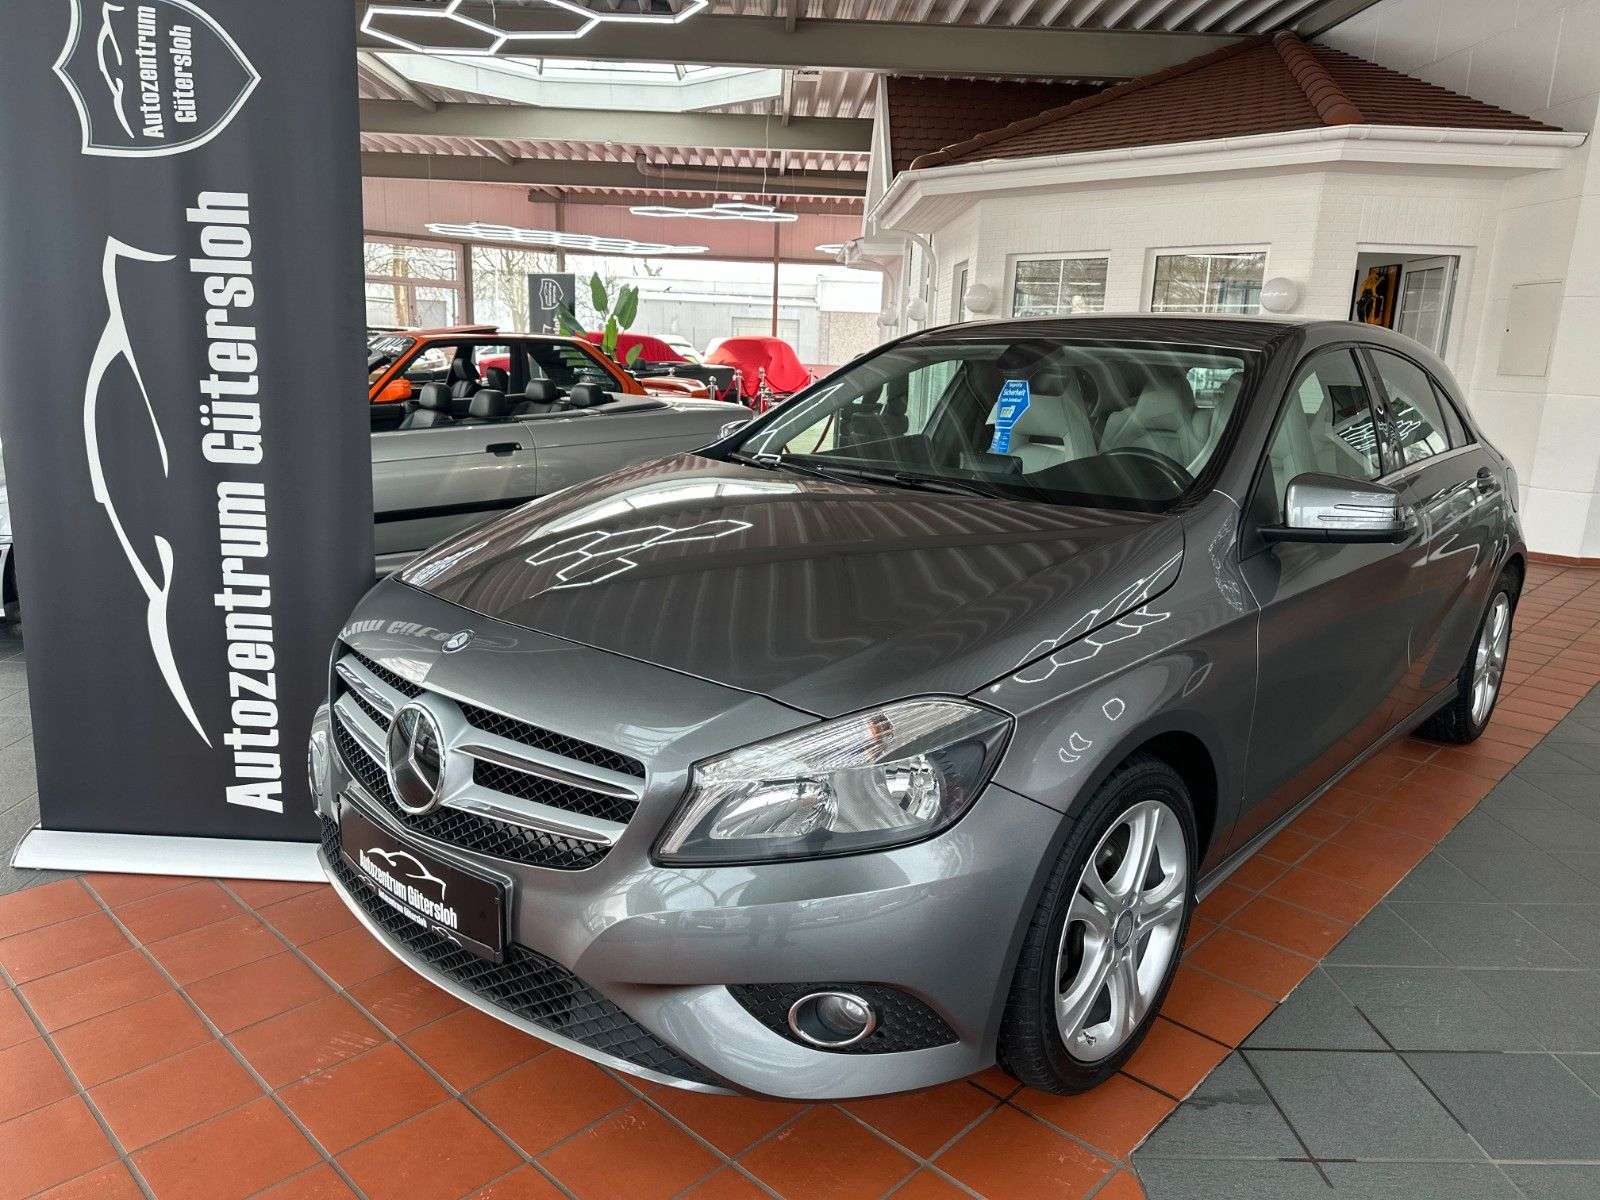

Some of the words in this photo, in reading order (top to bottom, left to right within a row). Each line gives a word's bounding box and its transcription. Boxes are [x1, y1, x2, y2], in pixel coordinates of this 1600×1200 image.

[136, 5, 165, 138] Autozentrum
[169, 25, 197, 124] Gütersloh
[186, 191, 264, 465] Gütersloh
[214, 481, 284, 814] Autozentrum
[359, 849, 407, 901] Autozentrum
[407, 885, 458, 929] Gütersloh
